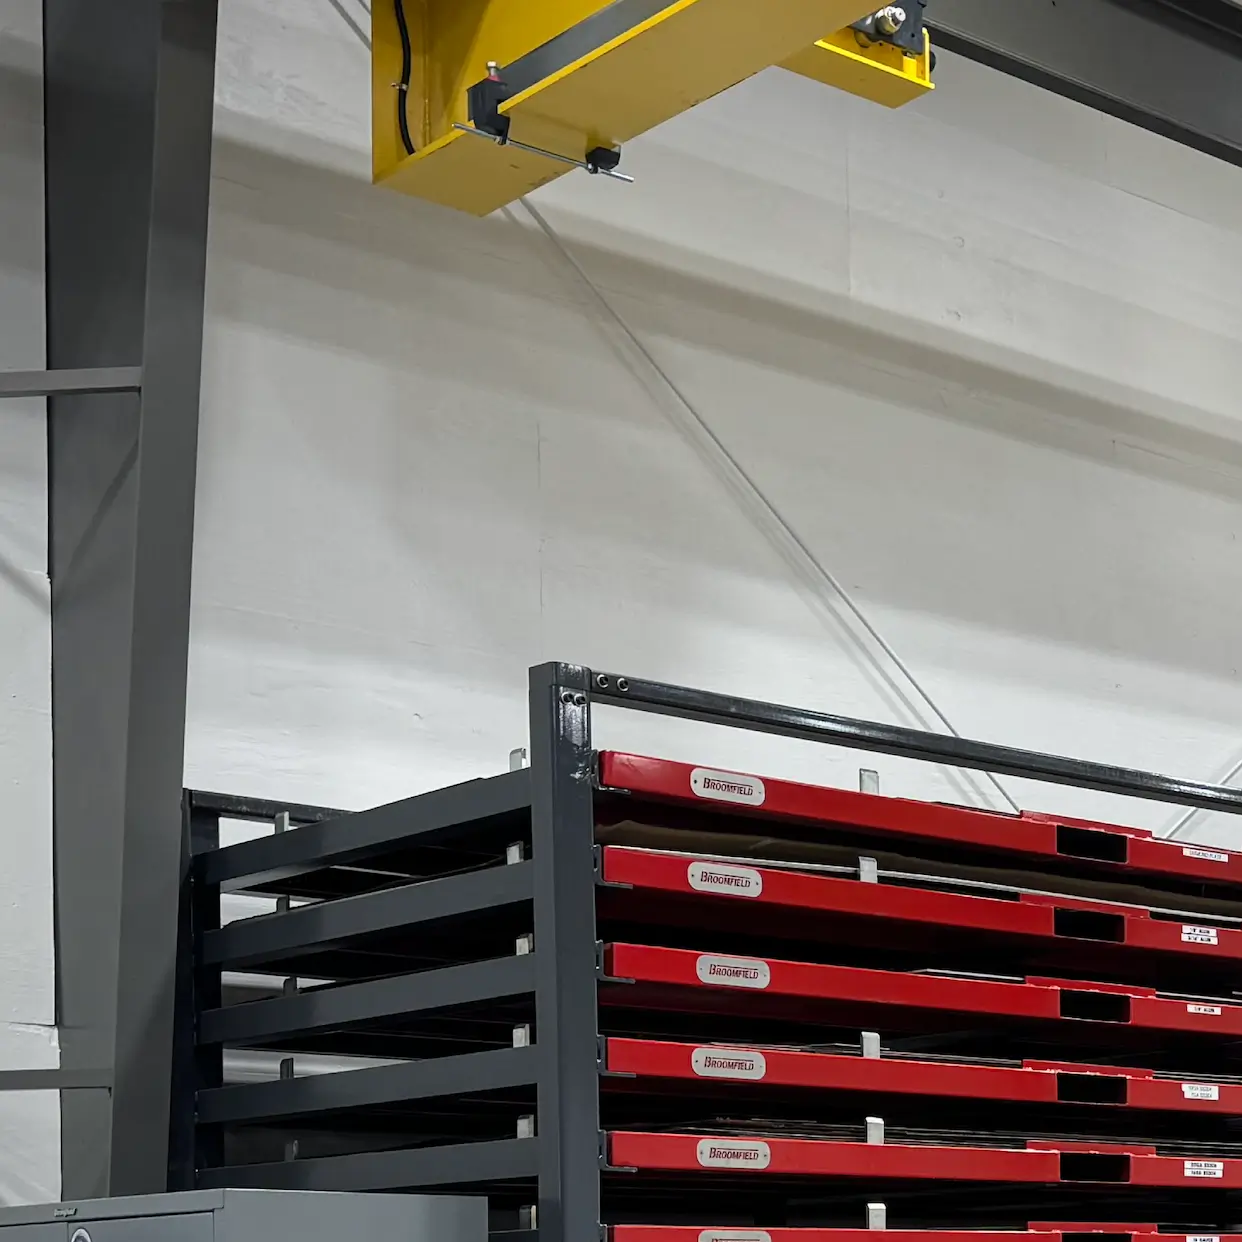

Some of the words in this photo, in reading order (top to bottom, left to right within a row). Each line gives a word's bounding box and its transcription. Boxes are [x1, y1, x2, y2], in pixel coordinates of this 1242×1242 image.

[703, 778, 753, 795] BROOMFIELD
[701, 871, 751, 888] BROOMFIELD
[709, 964, 758, 979] BROOMFIELD
[704, 1056, 754, 1070] BROOMFIELD
[709, 1148, 758, 1160] BROOMFIELD
